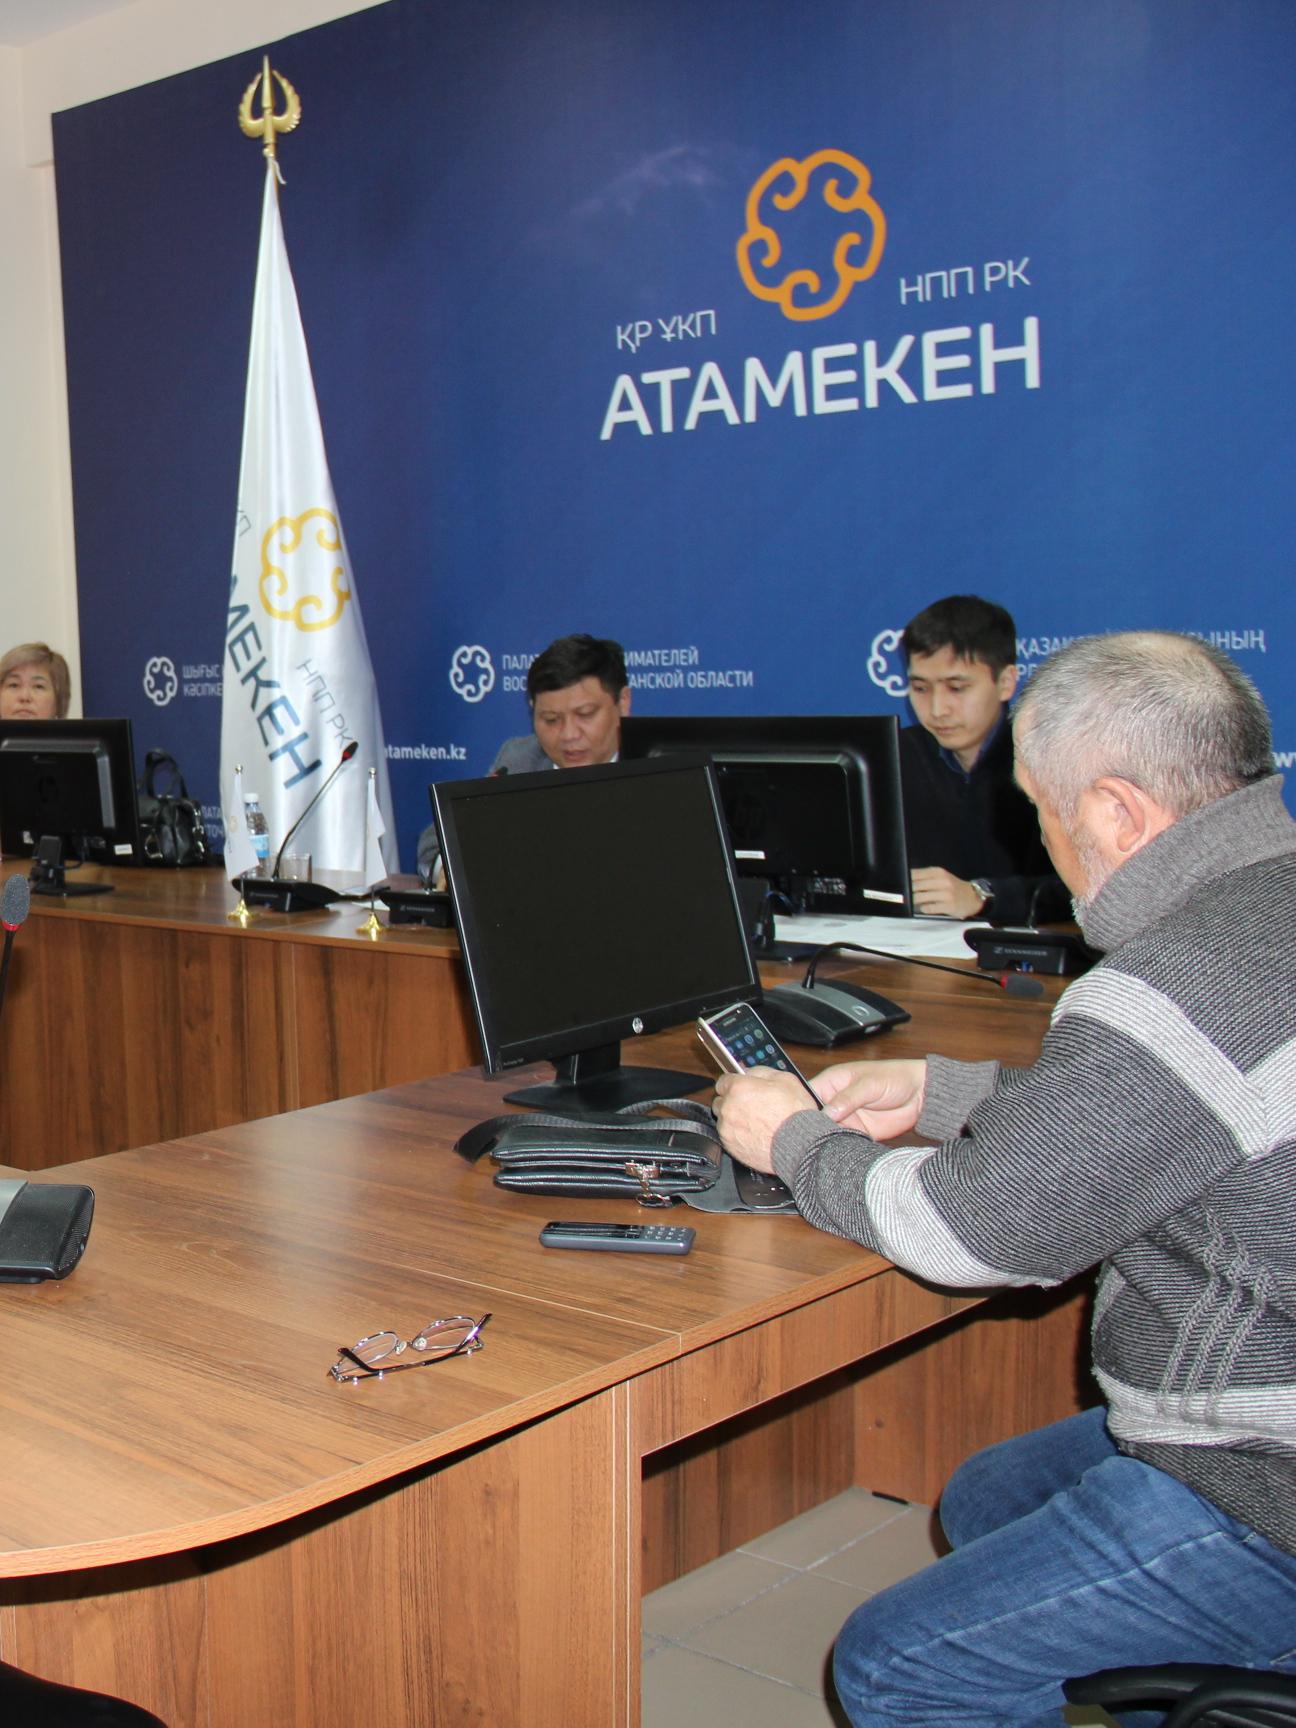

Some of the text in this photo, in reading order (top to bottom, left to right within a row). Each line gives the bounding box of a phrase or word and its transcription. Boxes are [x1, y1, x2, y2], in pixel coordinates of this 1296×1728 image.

[900, 257, 1031, 305] НПП РК
[600, 316, 1041, 440] АТАМЕКЕН
[623, 646, 699, 667] ИМАТЕЛЕЙ
[296, 659, 336, 714] НПП
[503, 676, 528, 691] ВОС
[687, 670, 754, 689] ОБЛАСТИ
